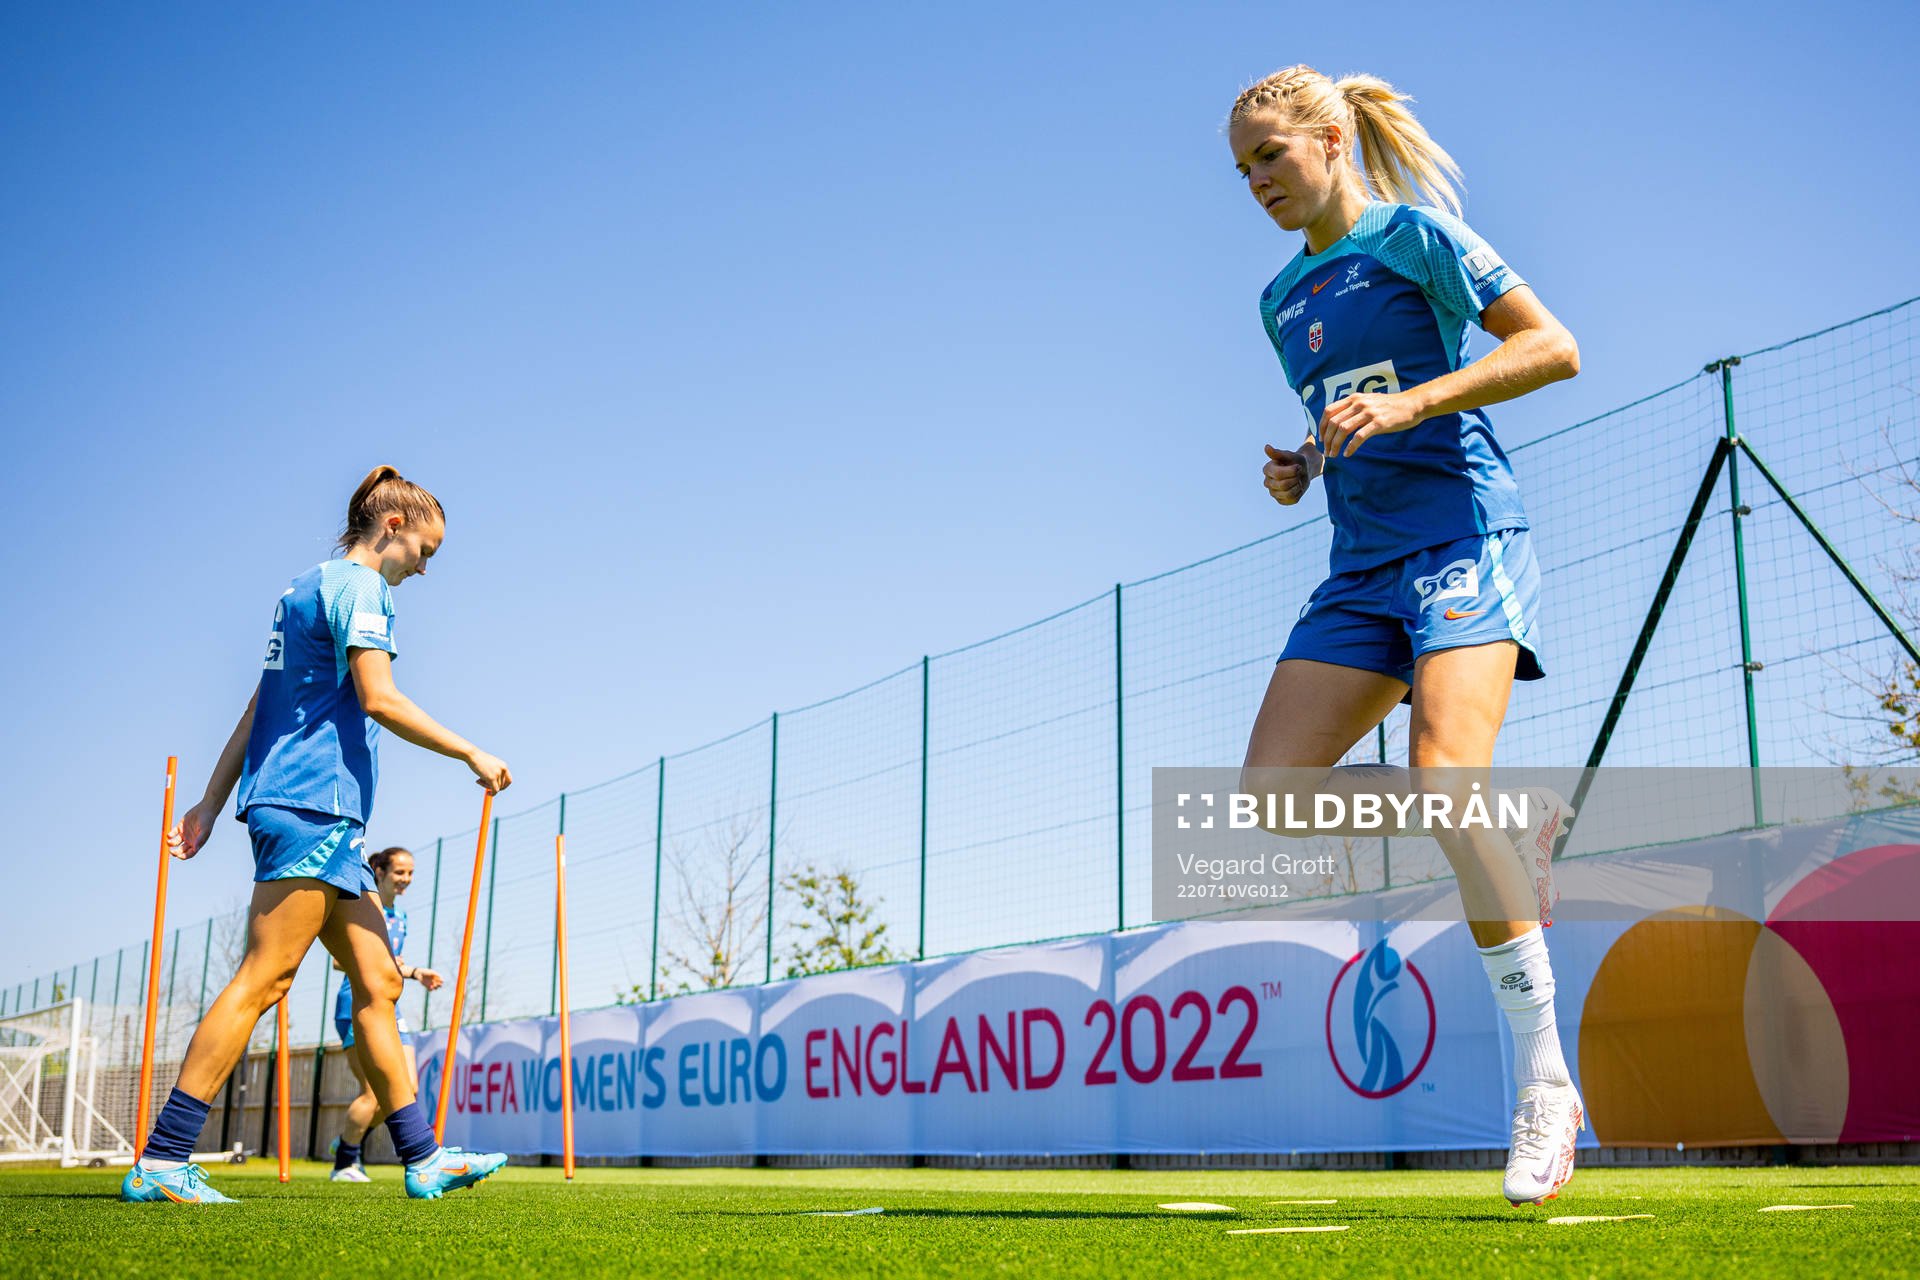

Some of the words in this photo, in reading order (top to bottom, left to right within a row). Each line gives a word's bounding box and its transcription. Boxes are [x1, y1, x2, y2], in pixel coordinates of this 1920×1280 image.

[1348, 280, 1371, 292] Tipping
[1276, 304, 1296, 328] KIWI
[1421, 566, 1467, 600] 5G
[453, 1062, 519, 1114] UEFA
[521, 1046, 667, 1114] WOMEN'S
[679, 1033, 788, 1107] EURO
[805, 1007, 1066, 1099] ENGLAND
[1084, 985, 1263, 1086] 2022
[1260, 981, 1282, 1000] TM
